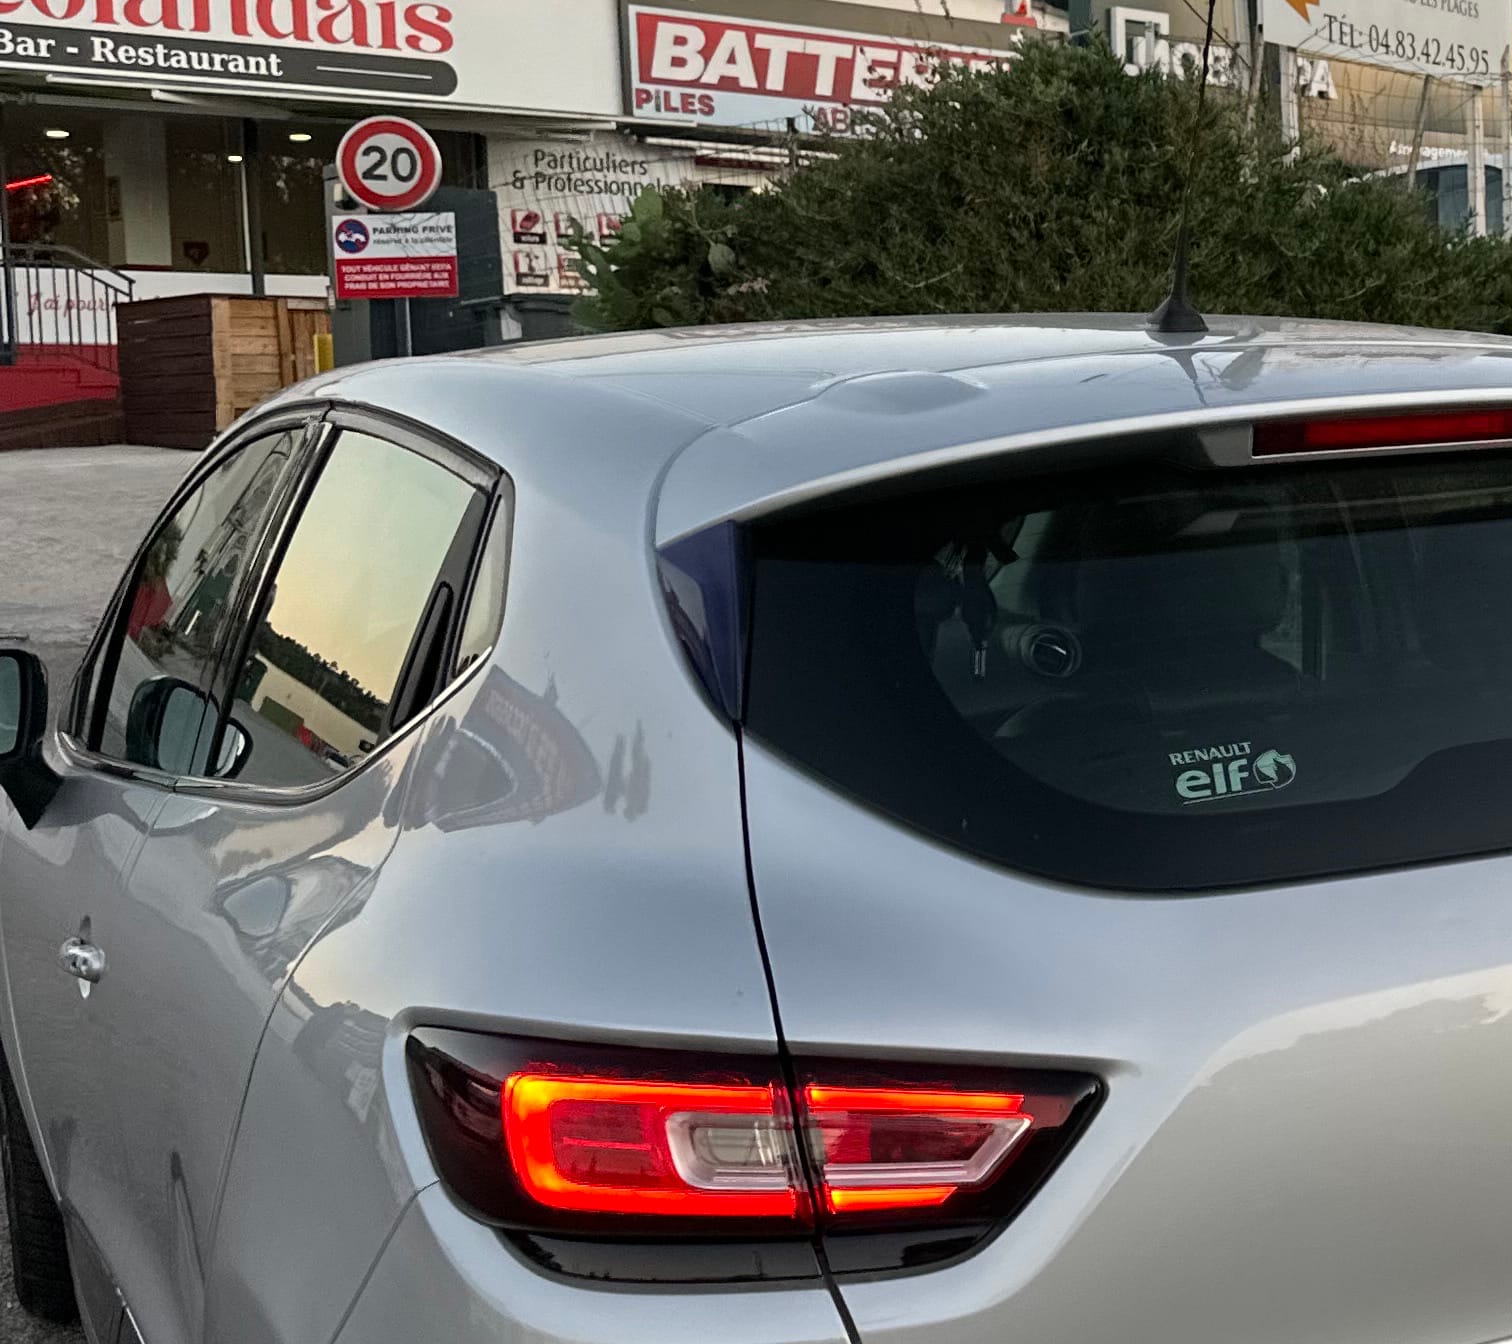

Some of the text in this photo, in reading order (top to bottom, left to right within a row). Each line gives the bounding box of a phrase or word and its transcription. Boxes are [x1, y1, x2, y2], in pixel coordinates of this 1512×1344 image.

[0, 27, 56, 58] Bar
[90, 36, 283, 77] Restaurant
[1368, 24, 1490, 76] 04.83.42.45.95
[360, 144, 418, 183] 20
[511, 169, 525, 191] &
[534, 148, 648, 176] Particuliers
[1168, 741, 1251, 766] RENAULT
[1176, 758, 1250, 798] elf
